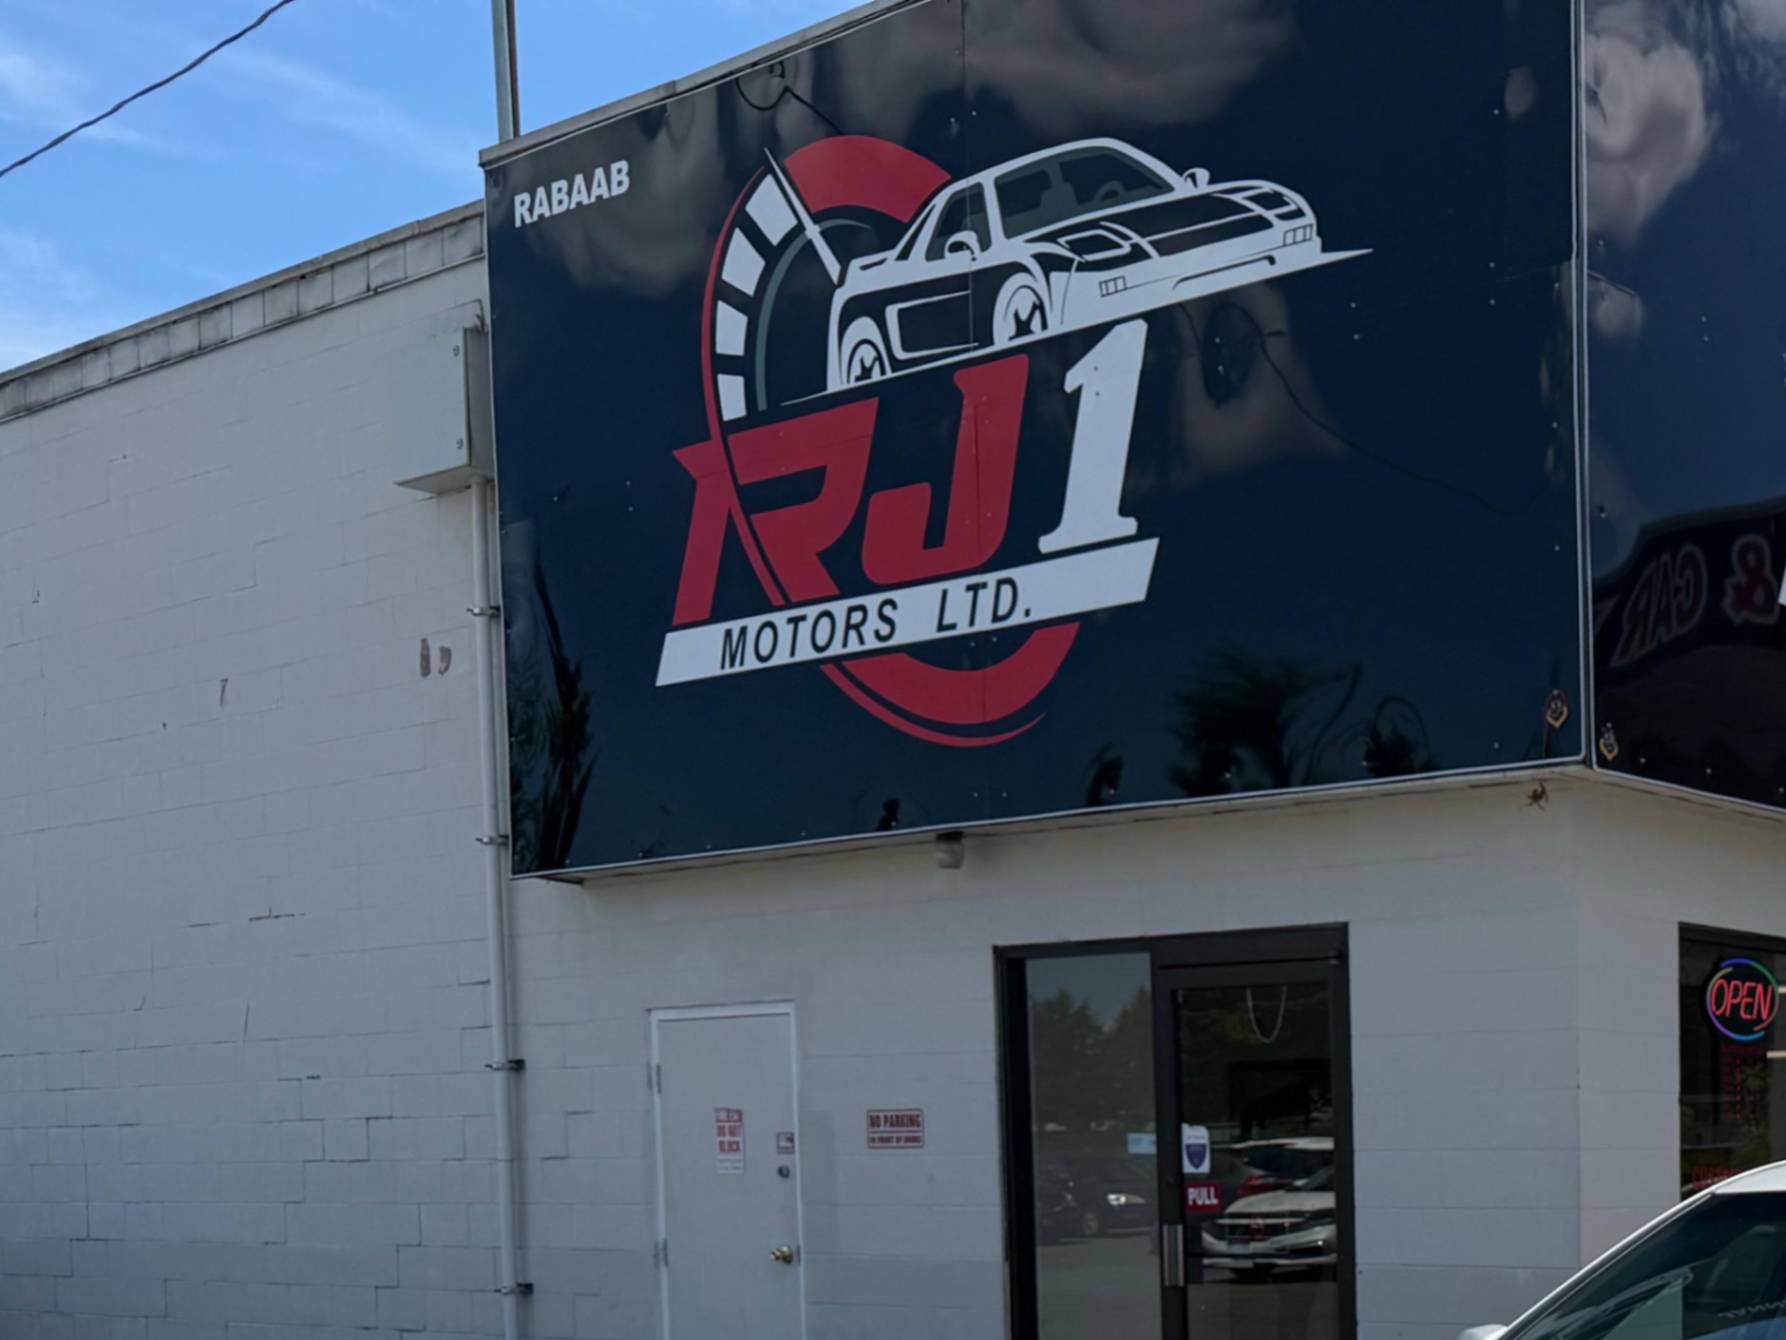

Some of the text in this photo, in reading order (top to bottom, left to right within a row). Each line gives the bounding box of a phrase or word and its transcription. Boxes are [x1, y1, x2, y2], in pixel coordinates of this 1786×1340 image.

[512, 159, 631, 228] RABAAB
[719, 576, 1033, 671] MOTORS LTD.
[1711, 978, 1774, 1021] OPEN
[1187, 1185, 1219, 1206] PULL
